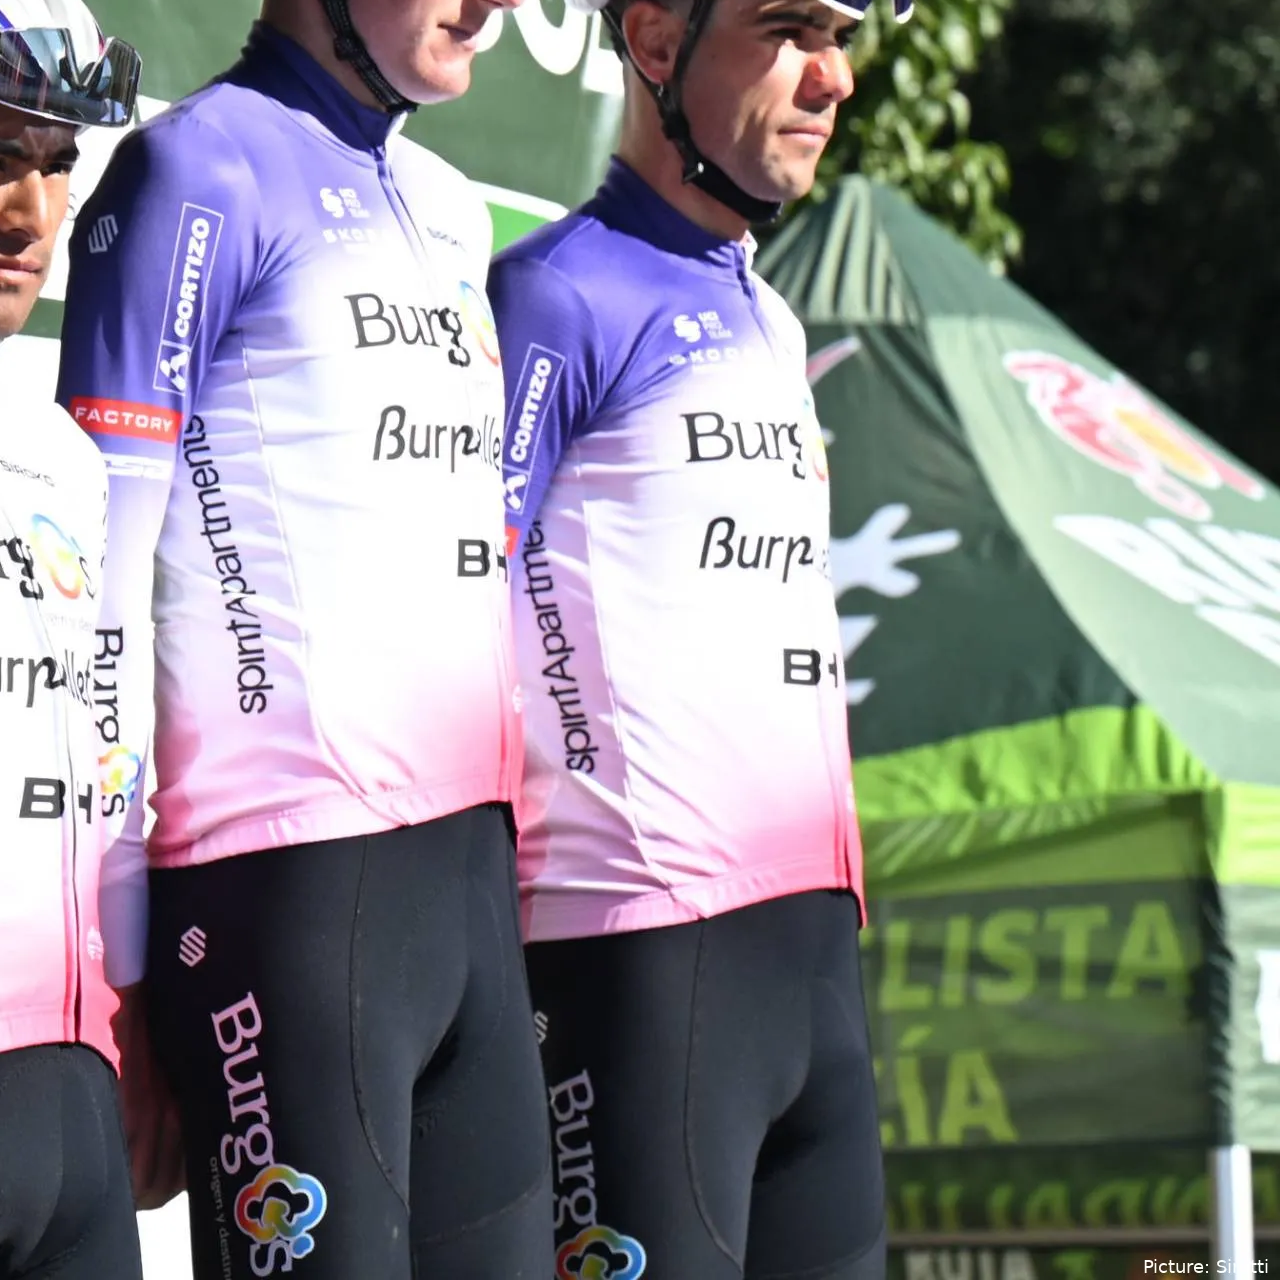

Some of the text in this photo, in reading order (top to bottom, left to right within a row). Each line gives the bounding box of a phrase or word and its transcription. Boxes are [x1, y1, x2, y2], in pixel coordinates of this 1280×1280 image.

[174, 217, 210, 339] CORTIZO
[74, 405, 174, 434] FACTORY
[509, 356, 553, 463] CORTIZO
[210, 990, 327, 1278] Burgos
